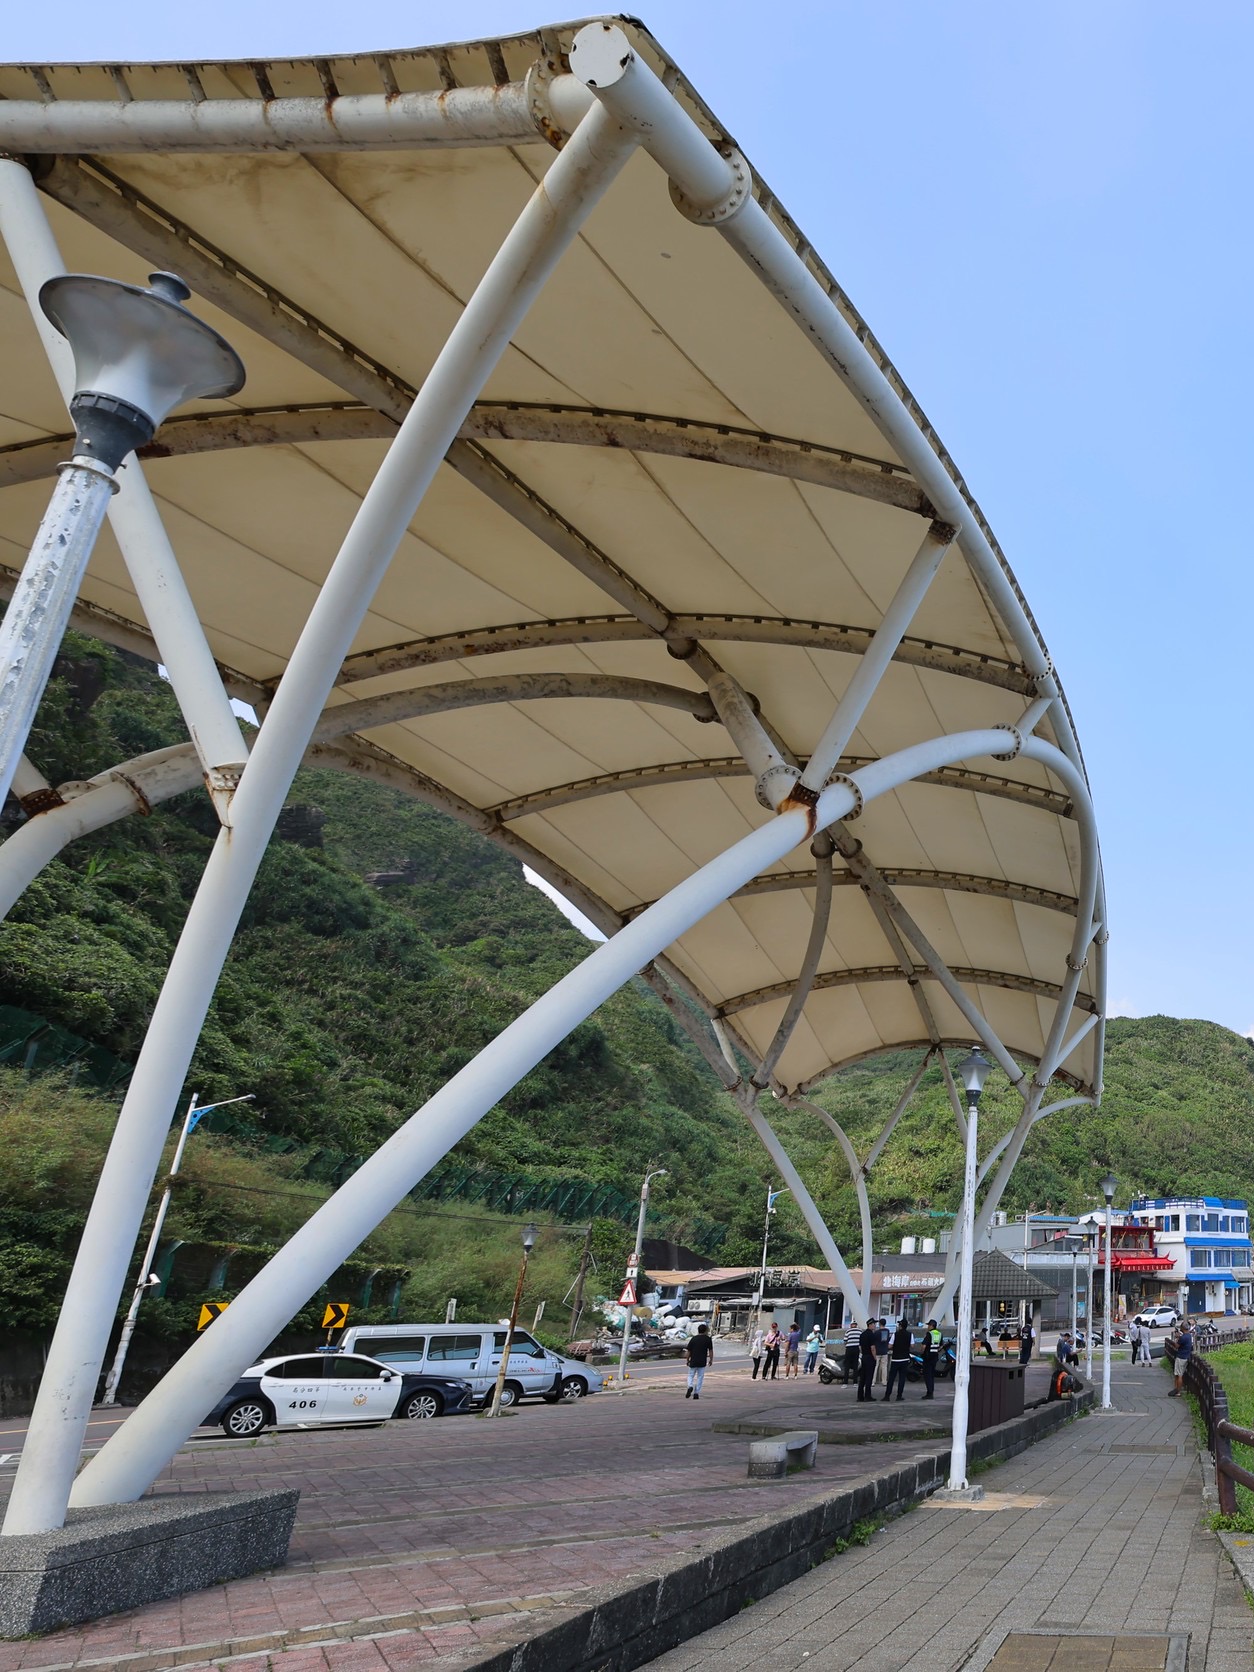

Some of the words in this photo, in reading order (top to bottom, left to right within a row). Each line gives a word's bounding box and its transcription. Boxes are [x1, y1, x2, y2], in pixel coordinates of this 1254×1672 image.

[883, 1274, 910, 1288] 北海岸
[289, 1400, 318, 1409] 406
